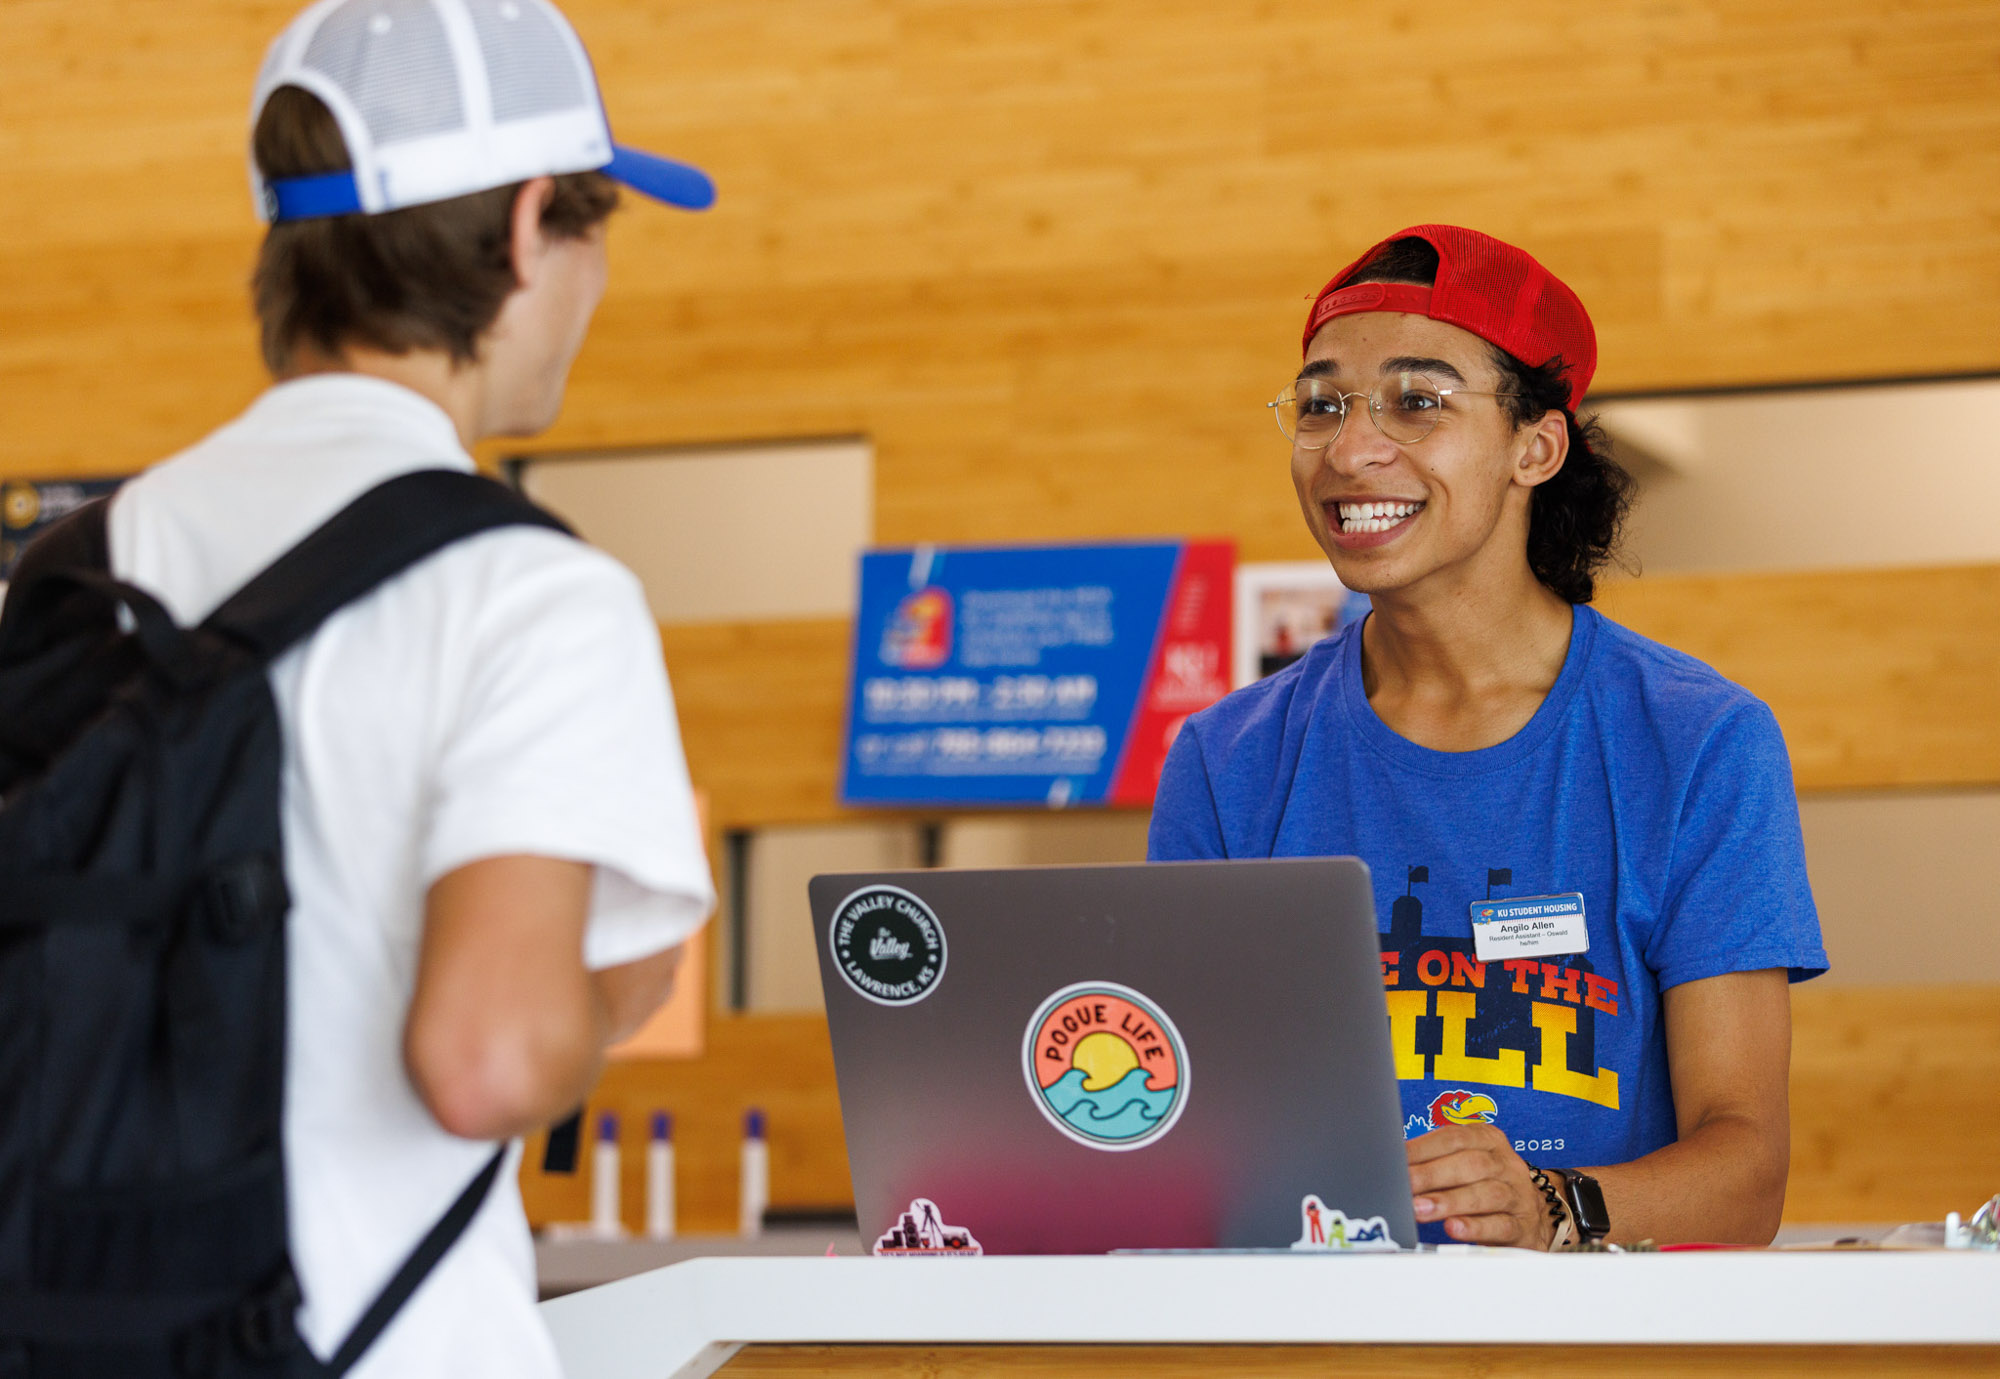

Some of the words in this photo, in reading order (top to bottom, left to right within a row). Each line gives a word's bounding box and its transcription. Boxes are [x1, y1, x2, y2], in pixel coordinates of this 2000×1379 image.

[838, 918, 855, 946] THE
[847, 896, 895, 921] VALLEY
[895, 899, 939, 949] CHURCH
[1497, 908, 1508, 917] KU
[1509, 906, 1542, 916] STUDENT
[1544, 903, 1578, 913] HOUSING
[1489, 934, 1514, 942] Resident
[1515, 932, 1541, 940] Assistant
[1546, 929, 1568, 937] Oswald
[1500, 923, 1530, 933] Angilo
[1531, 921, 1555, 930] Allen
[870, 937, 913, 960] Valley
[846, 961, 921, 997] LAWRENCE,
[917, 965, 935, 985] KS
[1416, 949, 1489, 988] ON
[1503, 959, 1619, 1017] THE
[1046, 1004, 1108, 1062] POGUE
[1121, 1012, 1165, 1060] LIFE
[1385, 990, 1620, 1111] ILL
[1514, 1138, 1565, 1151] 2023
